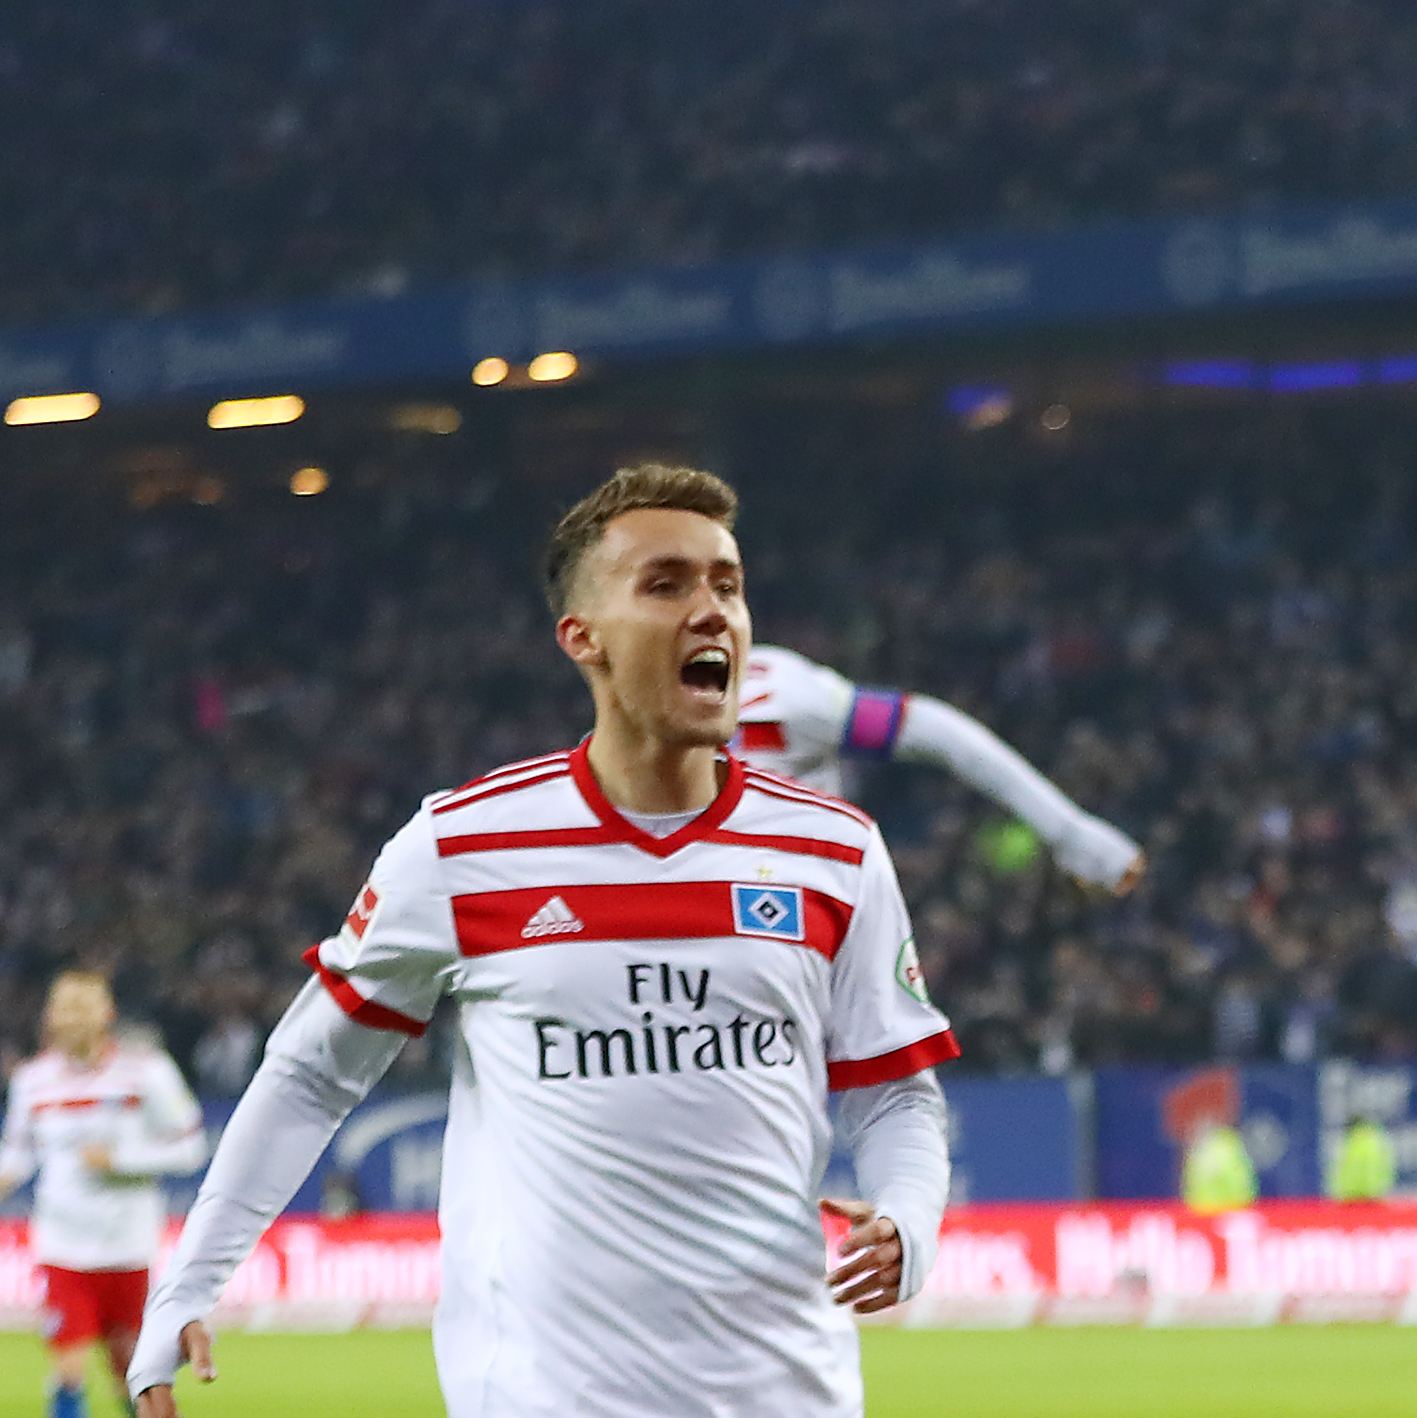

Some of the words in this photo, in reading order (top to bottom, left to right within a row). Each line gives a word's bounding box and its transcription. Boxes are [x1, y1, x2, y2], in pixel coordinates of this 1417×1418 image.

[521, 919, 585, 939] adidas
[626, 962, 710, 1011] Fly
[535, 1012, 797, 1081] Emirates
